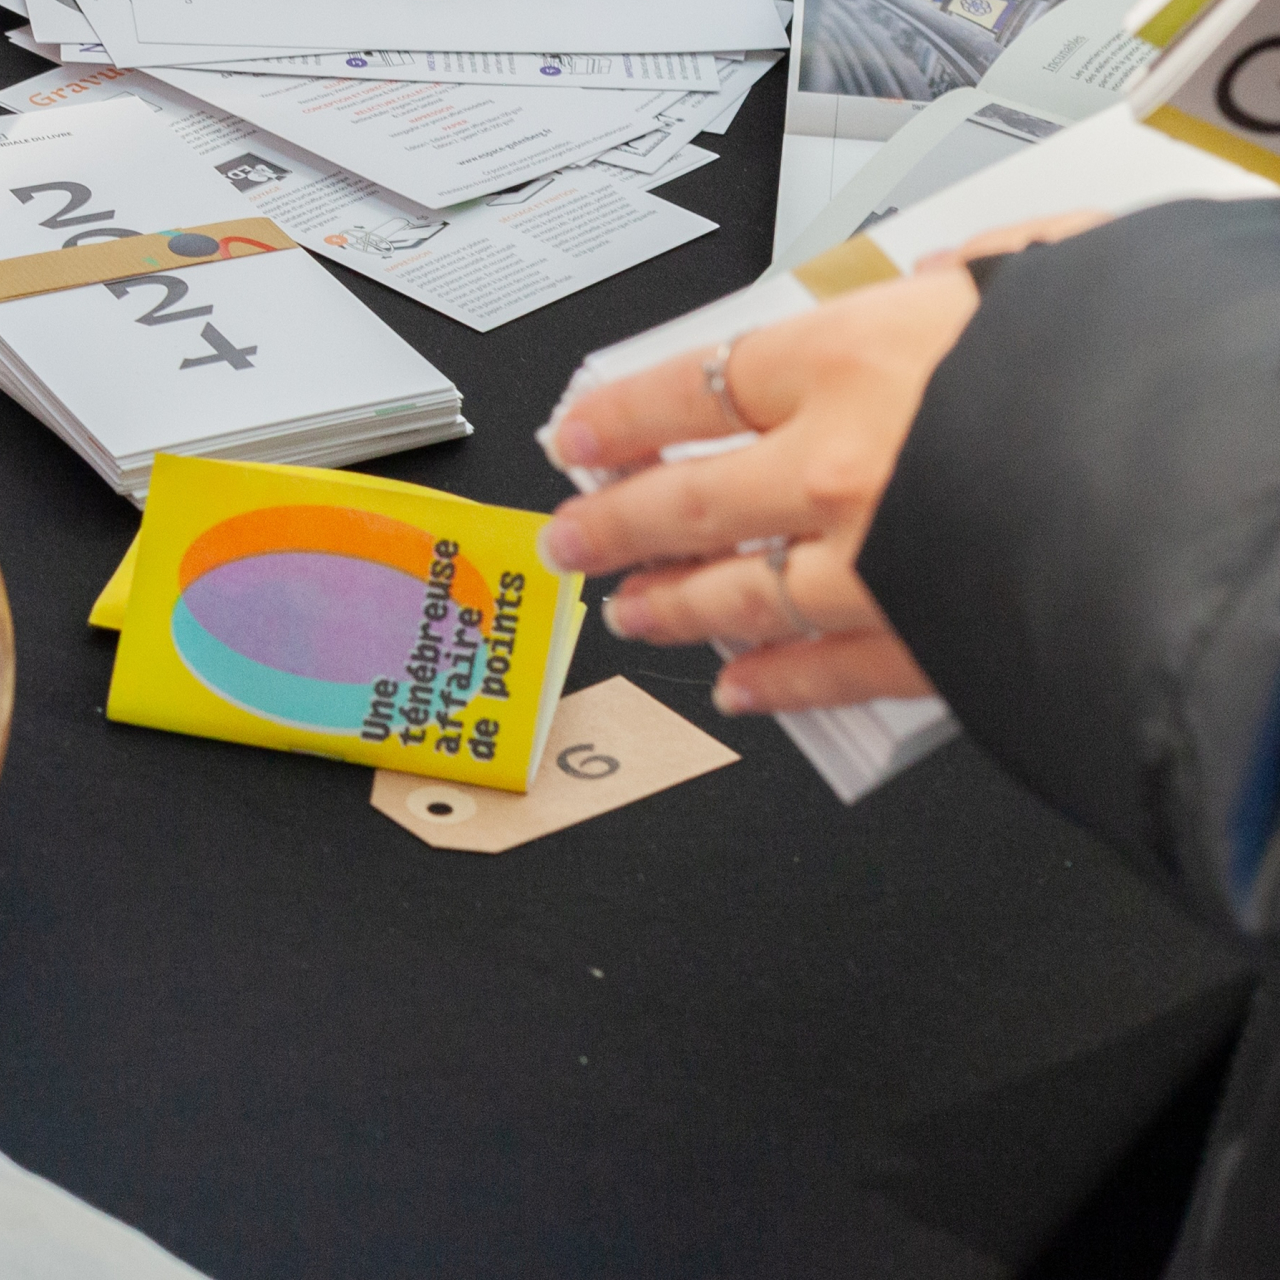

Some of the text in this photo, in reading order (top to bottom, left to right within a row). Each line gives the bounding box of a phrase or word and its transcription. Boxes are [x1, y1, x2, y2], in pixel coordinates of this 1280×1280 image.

[28, 67, 137, 108] Gravu
[46, 130, 75, 141] LIVRE
[9, 180, 258, 371] 224
[361, 676, 400, 744] Une
[398, 538, 460, 748] ténébreuse
[434, 606, 485, 756] affaire
[467, 570, 526, 762] de points
